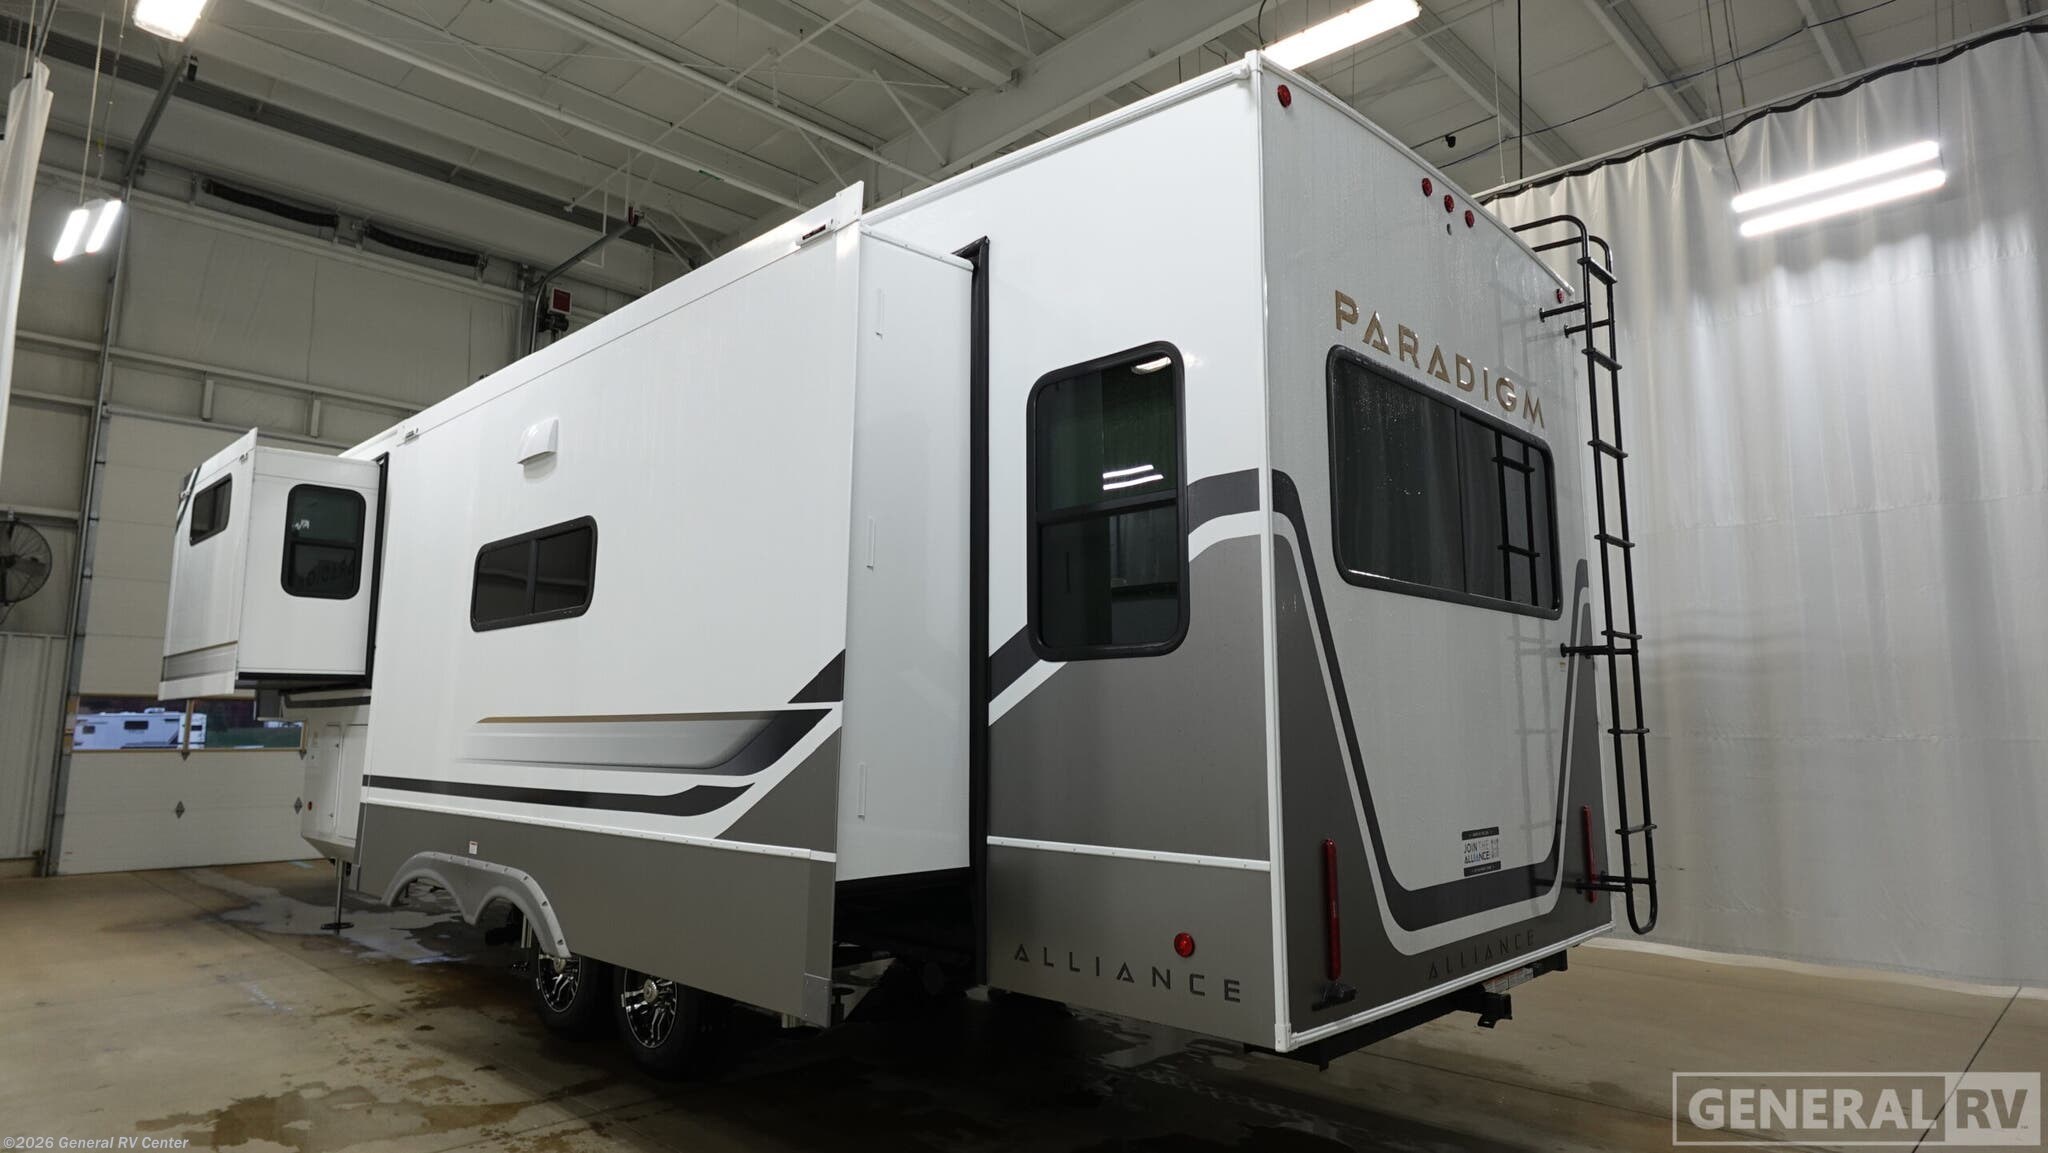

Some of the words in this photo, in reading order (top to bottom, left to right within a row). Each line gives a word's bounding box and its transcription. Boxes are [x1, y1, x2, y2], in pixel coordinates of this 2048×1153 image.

[1335, 289, 1545, 429] PARADIGM
[1464, 841, 1477, 854] JOIN
[1464, 851, 1490, 864] ALLIANCE
[1014, 943, 1241, 1003] ALLIANCE
[1428, 929, 1535, 980] ALLIANCE
